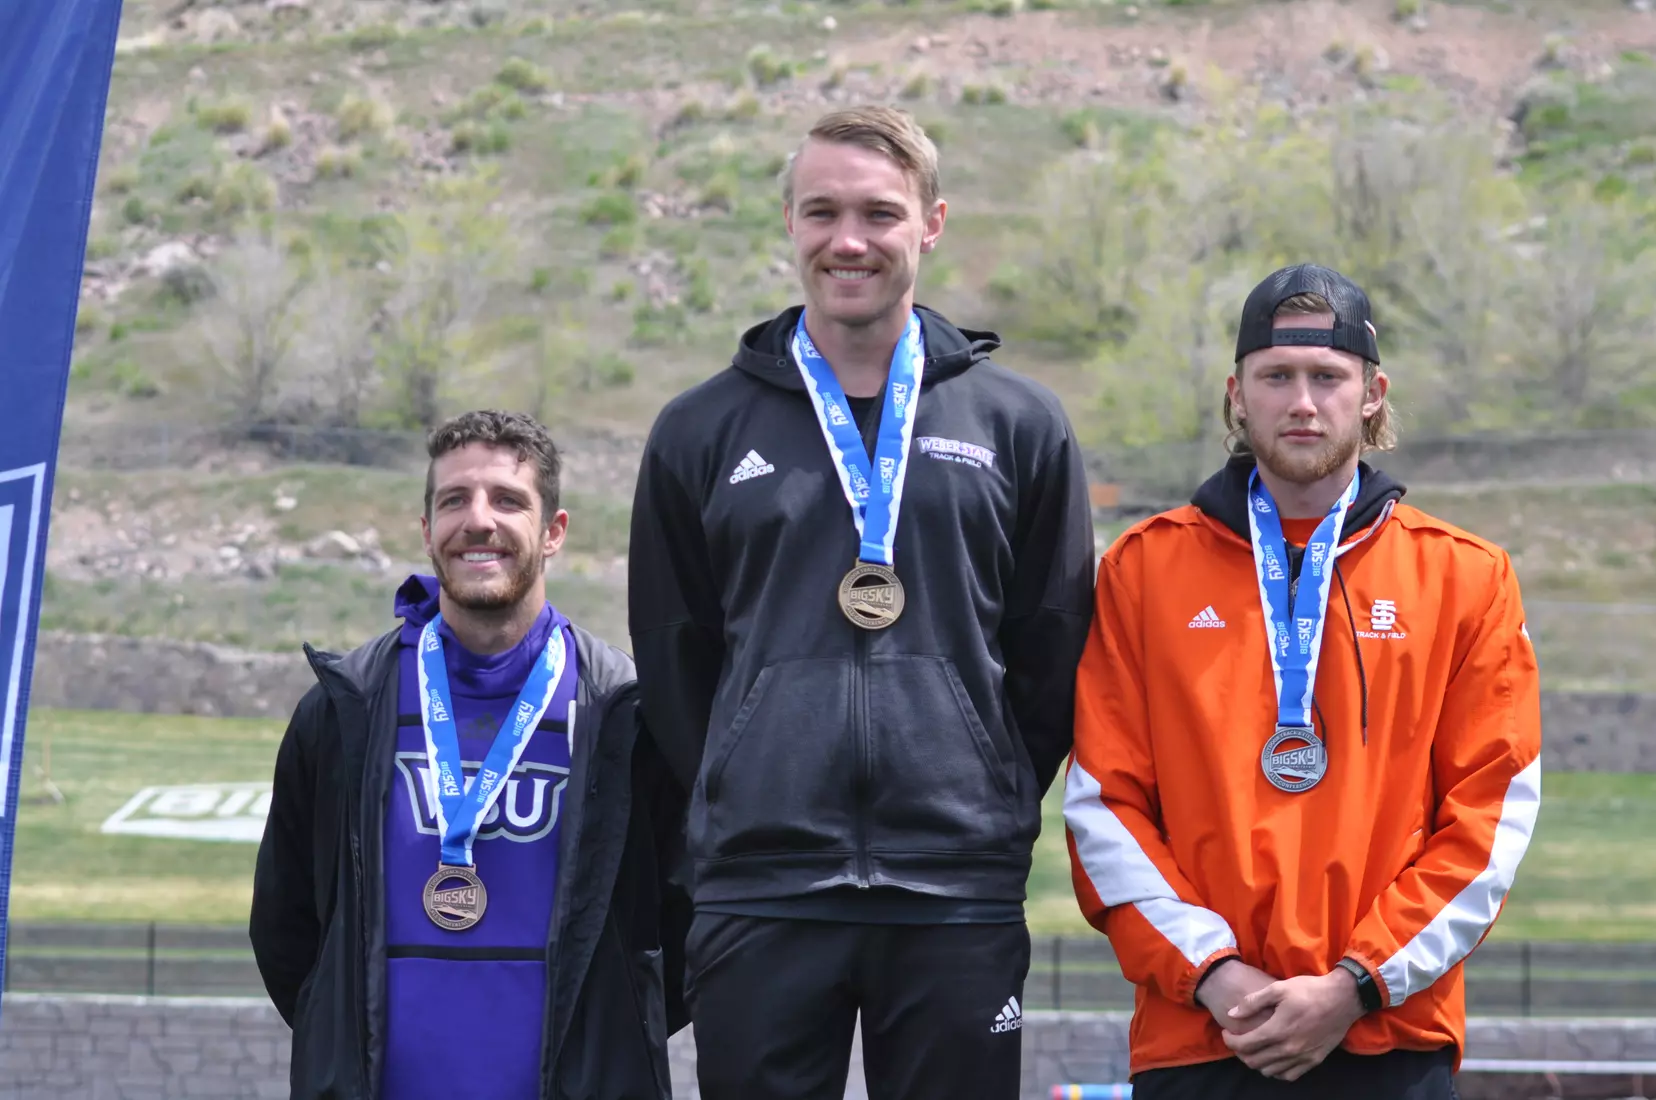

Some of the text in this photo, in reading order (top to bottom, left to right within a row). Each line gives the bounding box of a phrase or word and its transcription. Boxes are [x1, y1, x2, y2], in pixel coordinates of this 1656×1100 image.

[920, 438, 961, 451] WEBER
[929, 452, 954, 461] TRACK
[962, 457, 982, 468] FIELD
[729, 463, 775, 484] adidas
[1188, 619, 1226, 629] adidas
[1356, 631, 1379, 639] TRACK
[1381, 632, 1387, 640] &
